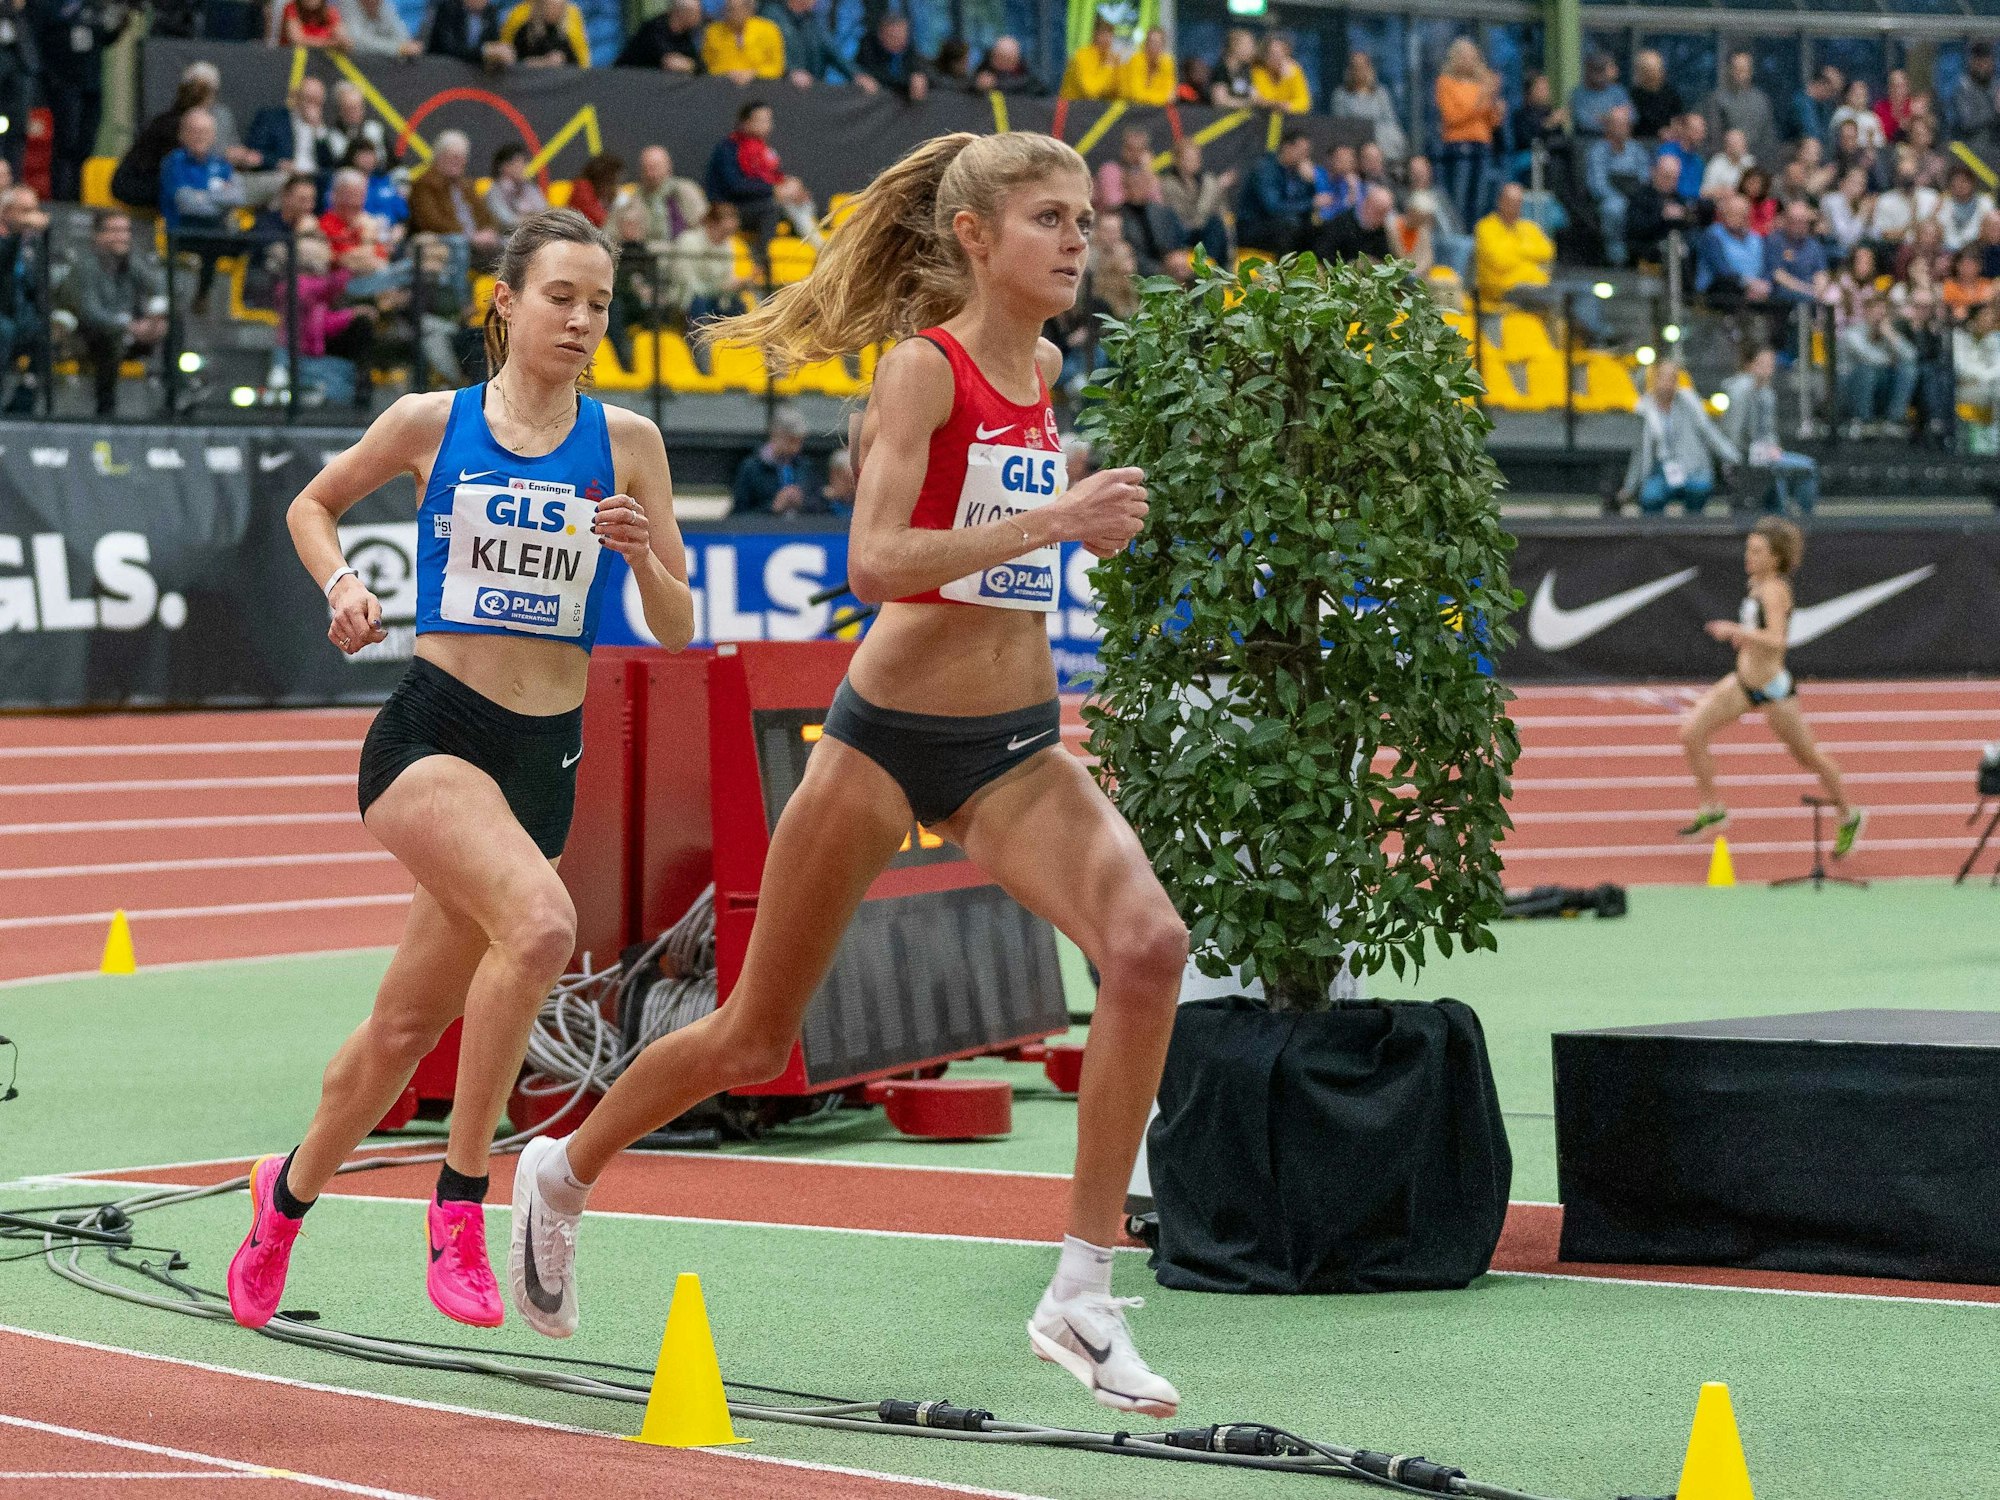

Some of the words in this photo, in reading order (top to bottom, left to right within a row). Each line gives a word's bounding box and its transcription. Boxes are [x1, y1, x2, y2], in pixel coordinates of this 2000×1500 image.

[528, 482, 572, 495] Ensinger
[471, 536, 581, 581] KLEIN
[1015, 571, 1052, 589] PLAN
[512, 596, 558, 616] PLAN
[572, 602, 581, 622] 453
[511, 612, 556, 624] INTERNATIONAL
